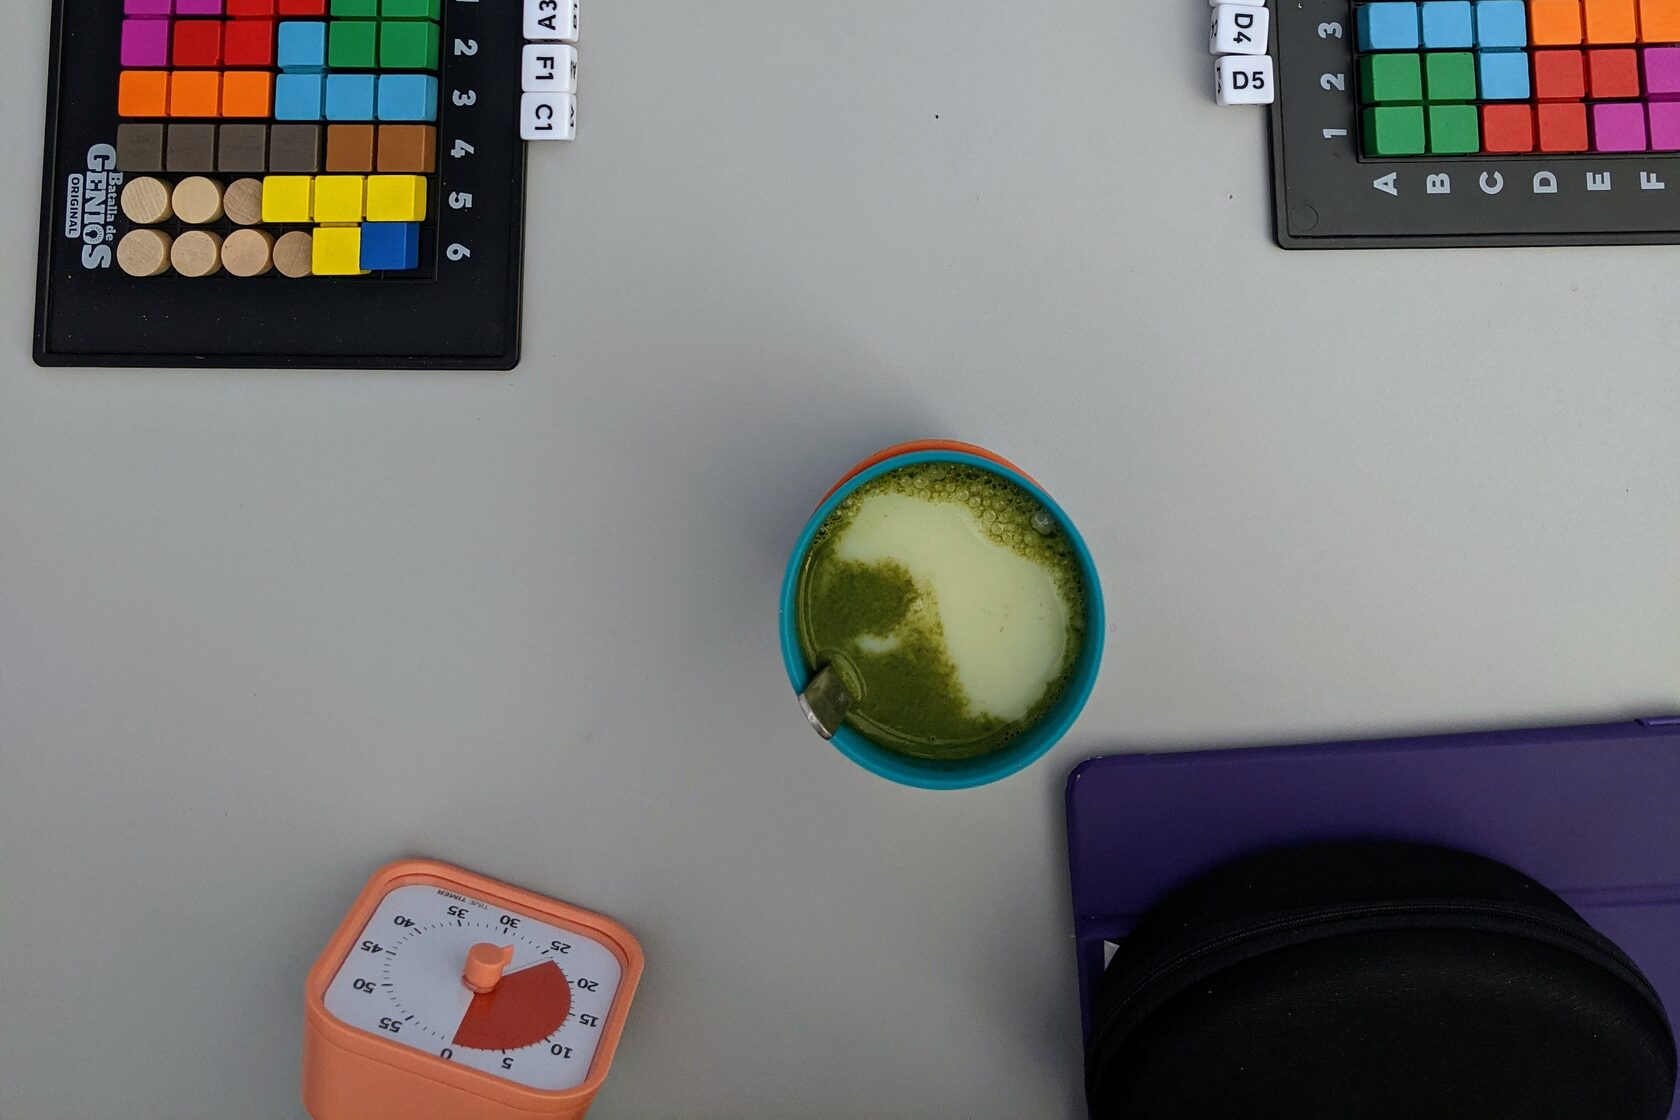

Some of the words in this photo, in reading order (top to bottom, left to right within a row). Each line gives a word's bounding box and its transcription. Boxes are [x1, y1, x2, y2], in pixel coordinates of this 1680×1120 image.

[538, 0, 557, 30] A3
[1234, 14, 1253, 43] D4
[1318, 22, 1342, 38] 3
[455, 39, 478, 55] 2
[536, 57, 554, 79] F1
[1233, 71, 1264, 89] D5
[1320, 74, 1344, 90] 2
[453, 90, 476, 106] 3
[535, 104, 553, 130] C1
[1323, 129, 1346, 138] 1
[451, 140, 474, 157] 4
[1374, 172, 1397, 196] A
[1427, 173, 1450, 193] B
[1480, 171, 1503, 194] C
[1533, 171, 1557, 193] D
[1587, 172, 1611, 190] E
[1640, 172, 1664, 189] F
[105, 171, 124, 221] Batalla
[449, 192, 472, 209] 5
[66, 177, 80, 235] ORIGINAL
[104, 225, 117, 242] de
[447, 243, 470, 260] 6
[437, 889, 467, 903] TIMER
[446, 905, 469, 920] 35
[394, 914, 415, 929] 40
[499, 914, 521, 929] 30
[360, 940, 384, 955] 45
[549, 940, 572, 954] 25
[353, 978, 376, 994] 50
[577, 977, 600, 992] 20
[378, 1016, 403, 1034] 55
[579, 1013, 599, 1028] 15
[550, 1043, 573, 1059] 10
[501, 1057, 514, 1070] 5
